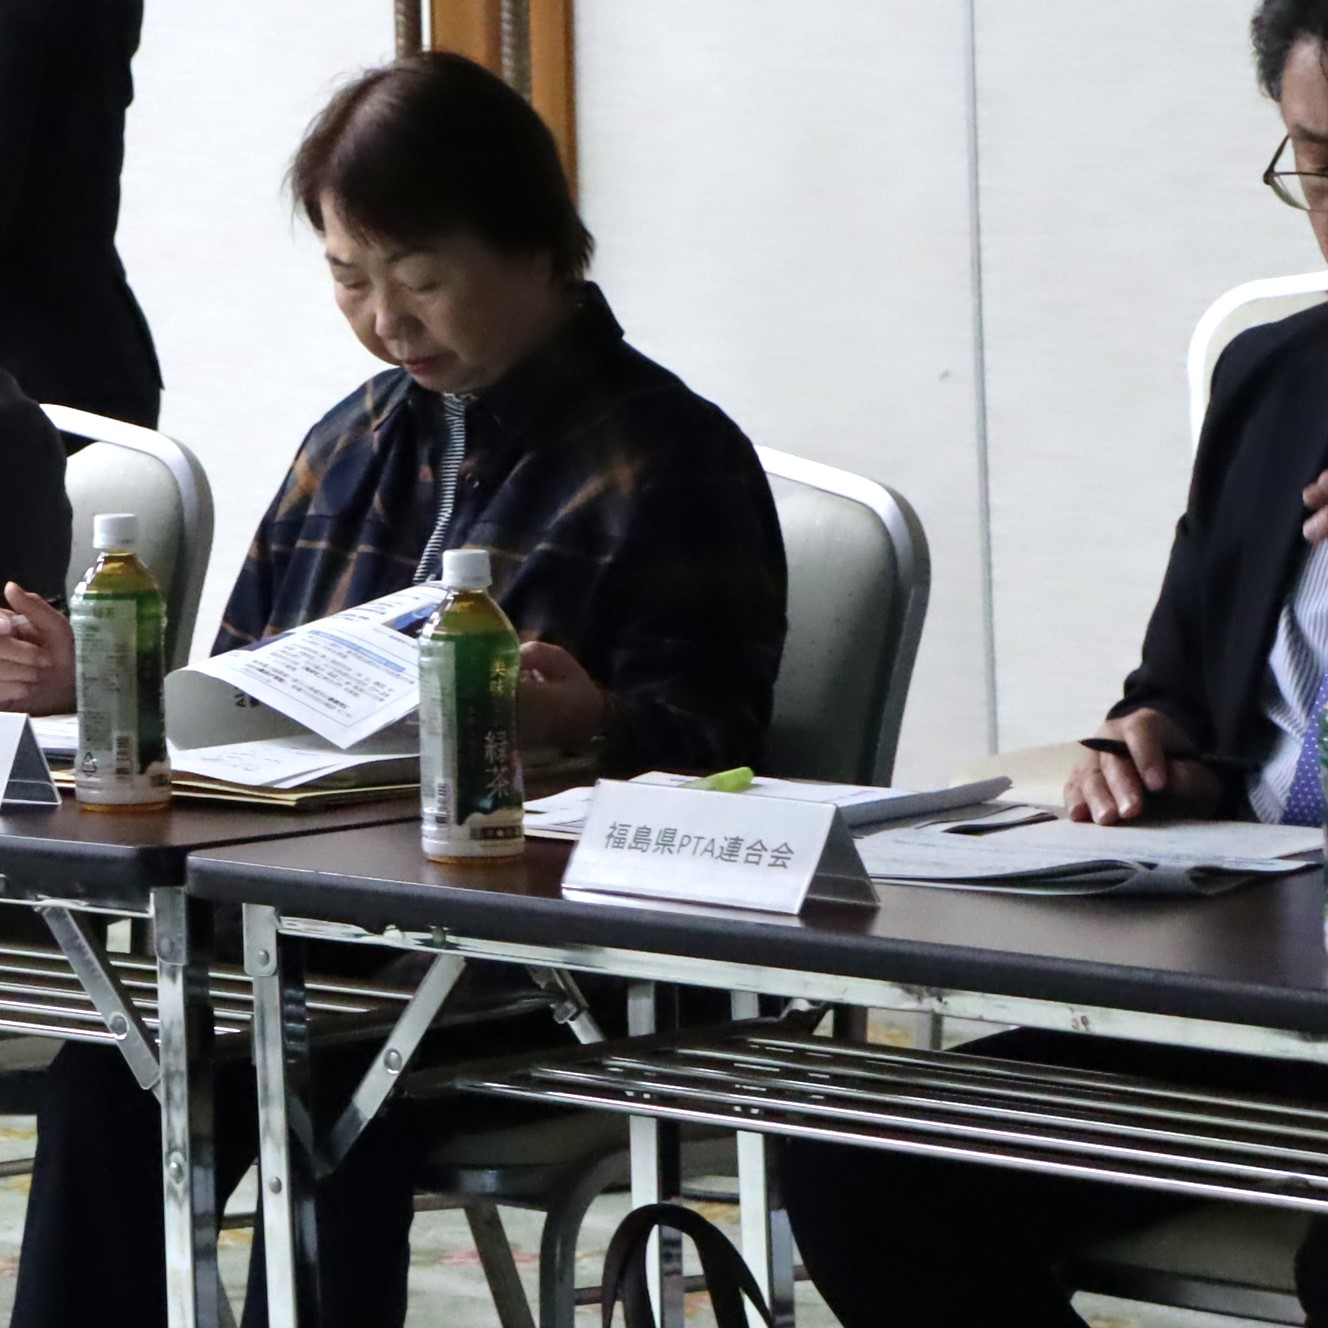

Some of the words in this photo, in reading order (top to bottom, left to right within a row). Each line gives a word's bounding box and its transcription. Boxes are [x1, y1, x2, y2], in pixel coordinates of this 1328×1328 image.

[604, 821, 794, 870] 福島県PTA連合会
